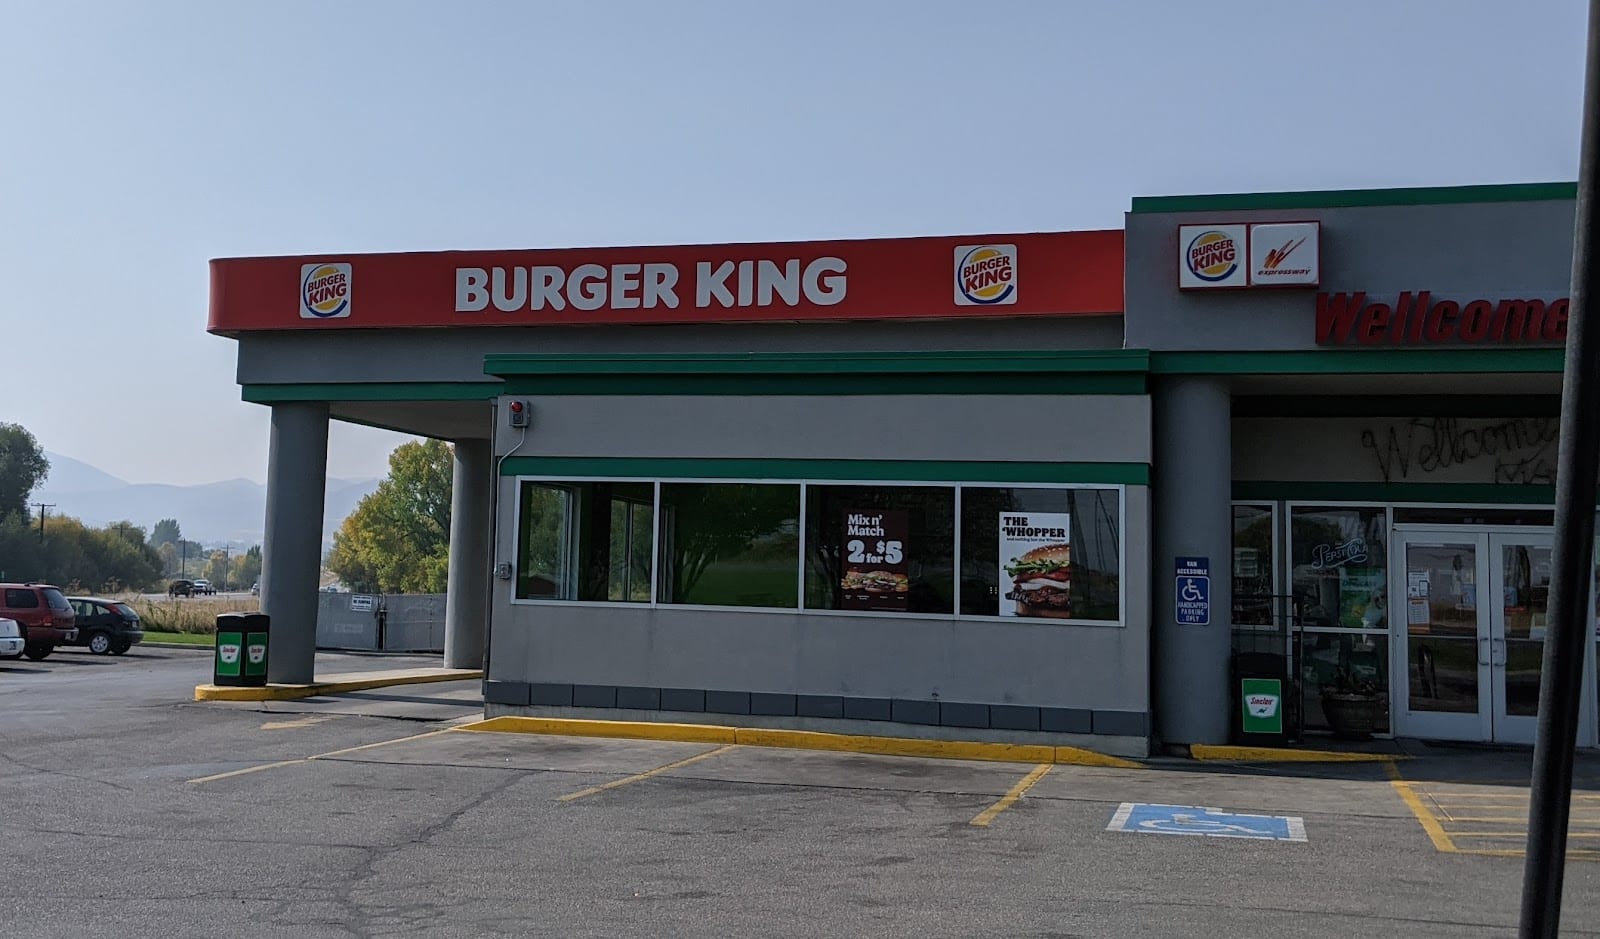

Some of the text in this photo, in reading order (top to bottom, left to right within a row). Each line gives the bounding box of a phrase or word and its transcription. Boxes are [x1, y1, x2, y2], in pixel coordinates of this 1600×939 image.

[1192, 239, 1233, 258] BURGER
[963, 255, 1010, 278] BURGER
[1193, 249, 1235, 273] KING
[965, 266, 1012, 293] KING
[1258, 268, 1311, 277] expressway
[308, 273, 346, 293] BURGER
[454, 256, 848, 312] BURGER KING
[308, 283, 347, 306] KING
[1315, 290, 1569, 345] Wellcome
[848, 513, 870, 525] Mix
[1003, 516, 1028, 526] THE
[847, 525, 885, 537] Match
[1002, 526, 1066, 538] WHOPPER
[847, 539, 865, 564] 2
[866, 552, 884, 564] for
[1180, 608, 1205, 616] PARKING
[1250, 696, 1273, 705] Sinclair
